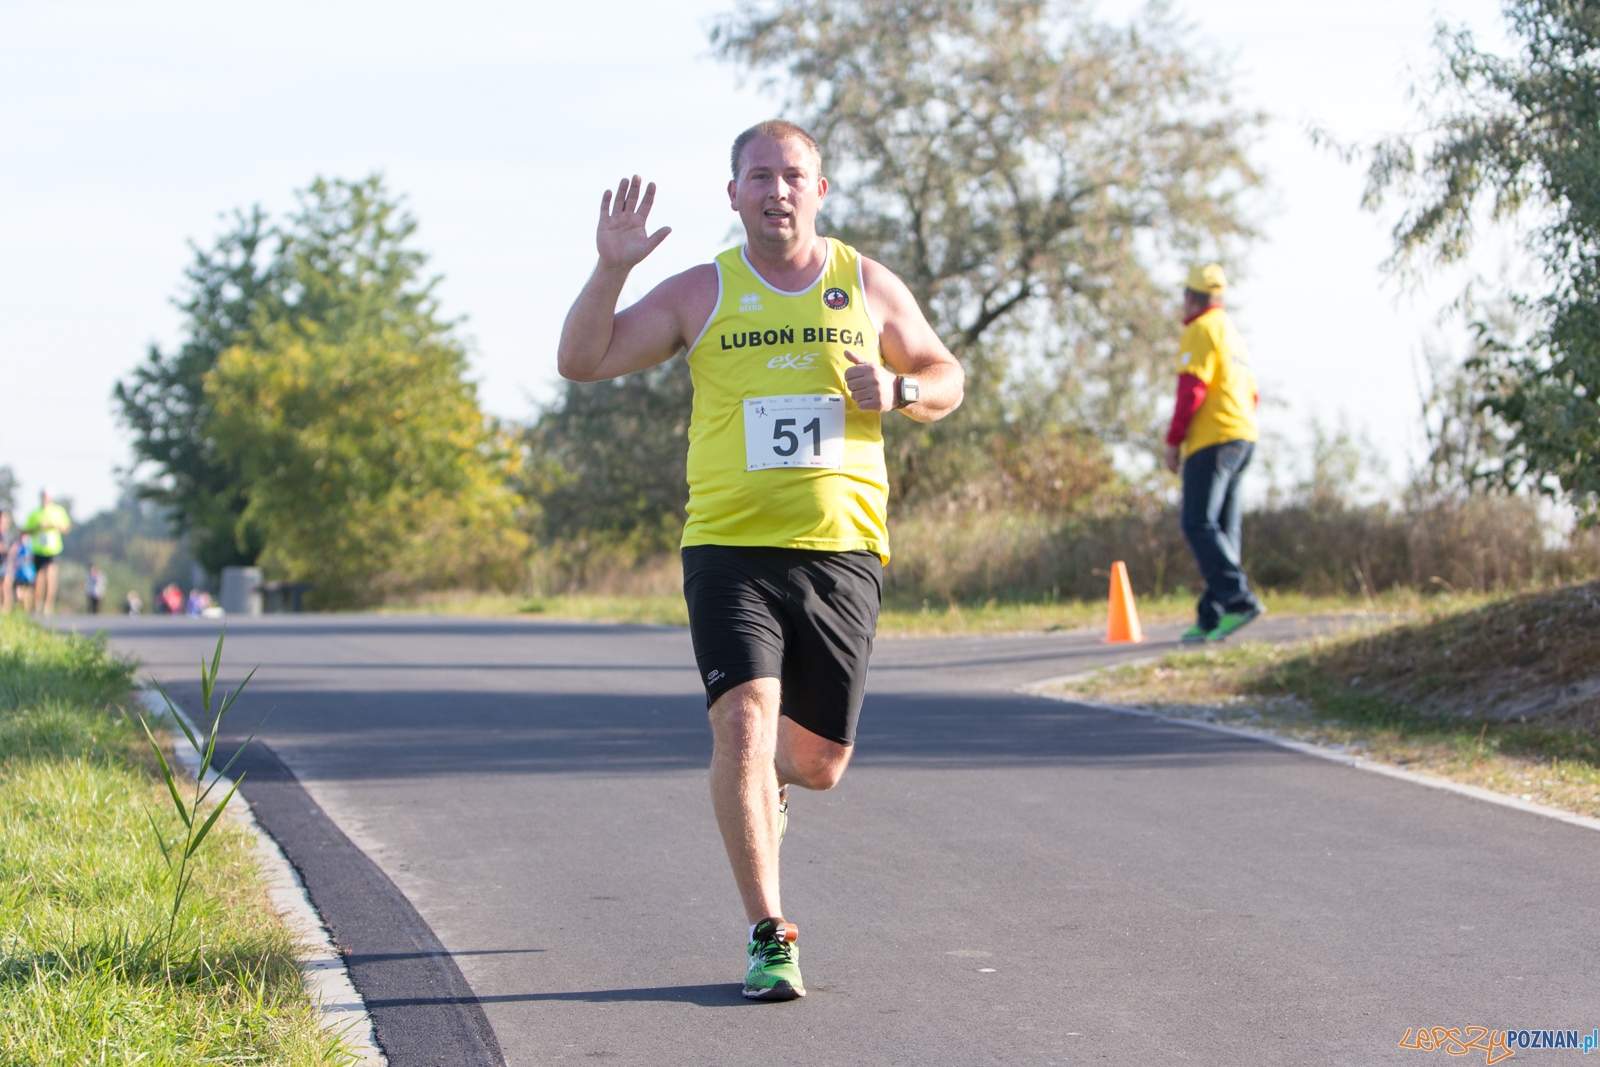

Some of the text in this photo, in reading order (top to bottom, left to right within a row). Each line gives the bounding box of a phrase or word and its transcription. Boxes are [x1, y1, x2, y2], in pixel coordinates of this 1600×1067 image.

[721, 325, 864, 350] LUBOŃ BIEGA
[772, 417, 821, 457] 51
